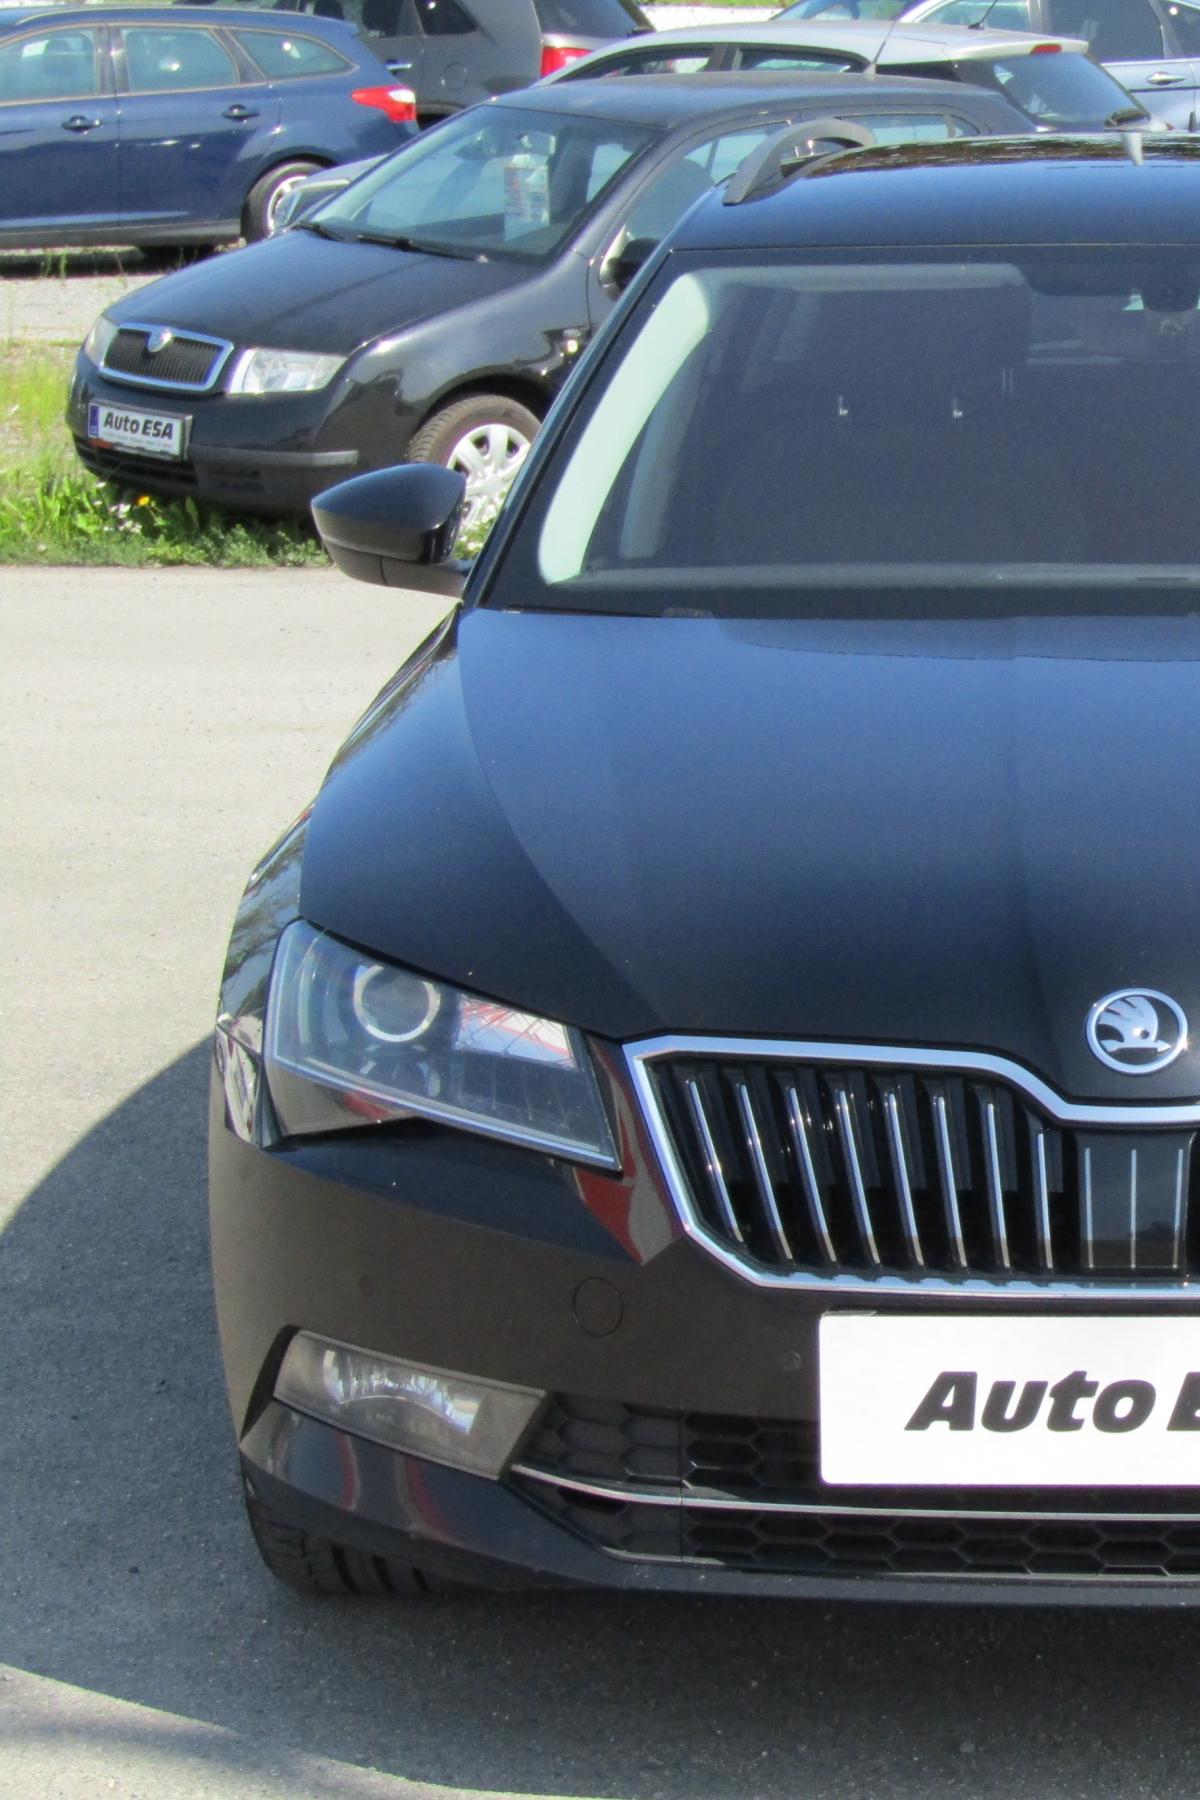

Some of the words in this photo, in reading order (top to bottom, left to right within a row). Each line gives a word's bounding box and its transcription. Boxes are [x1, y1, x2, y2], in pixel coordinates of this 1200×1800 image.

[104, 412, 140, 434] Auto
[142, 419, 173, 440] ESA
[905, 1371, 1155, 1432] Auto
